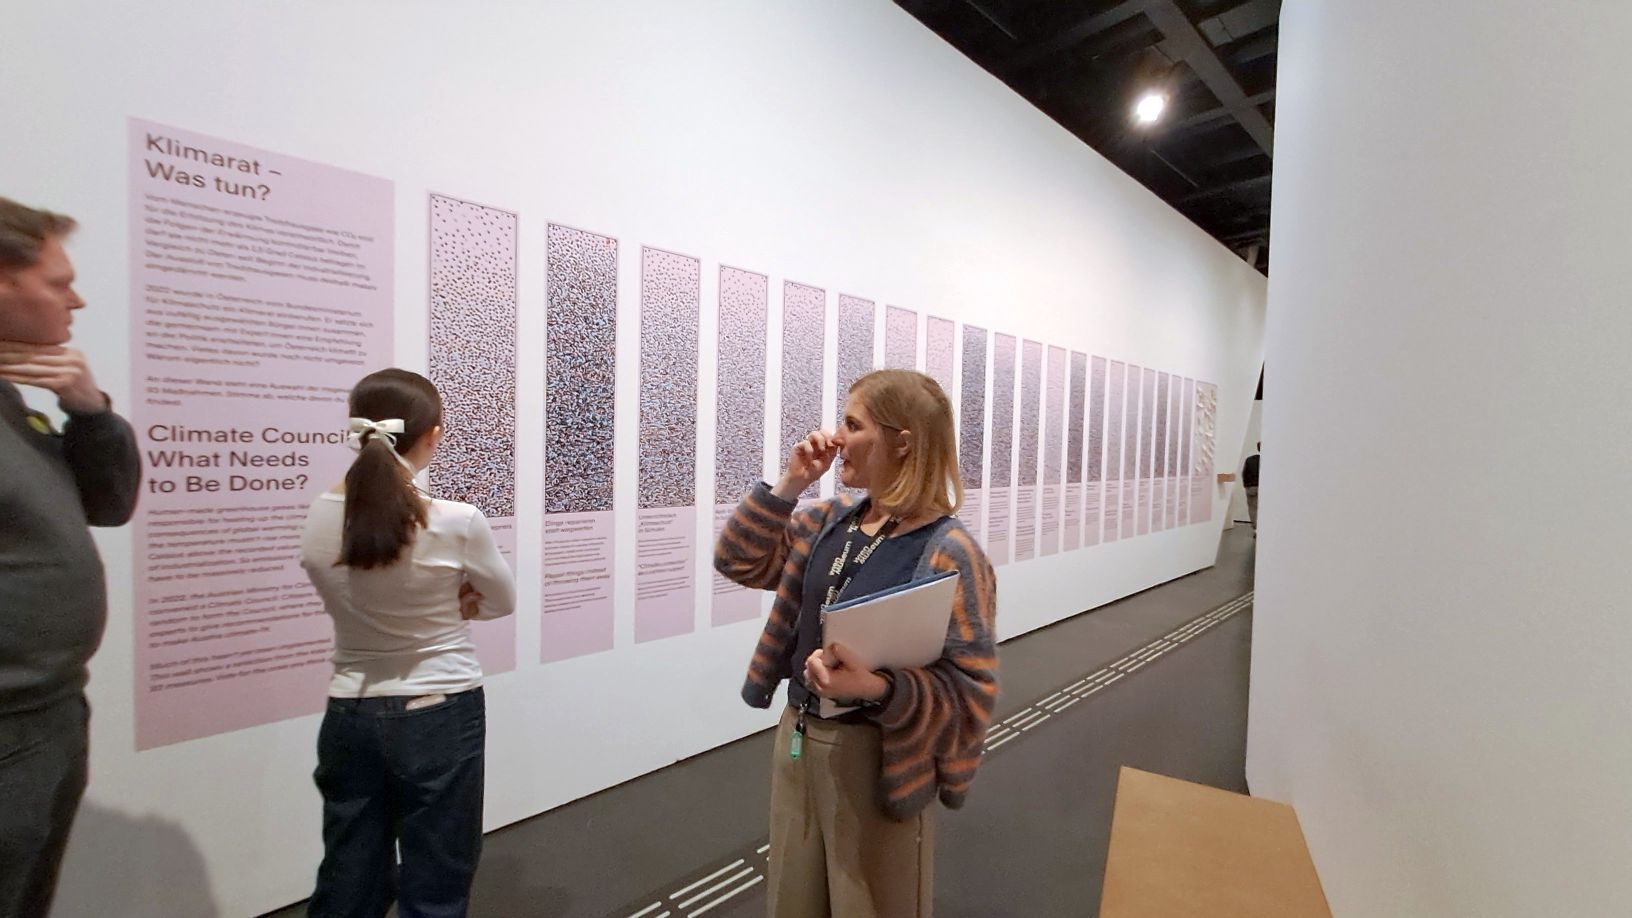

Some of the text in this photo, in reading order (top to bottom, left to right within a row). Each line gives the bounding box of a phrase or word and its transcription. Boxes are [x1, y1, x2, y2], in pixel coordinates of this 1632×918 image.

[145, 132, 261, 177] Klimarat
[144, 158, 272, 202] Was tun?
[147, 424, 254, 444] Climate
[148, 450, 310, 467] What Needs
[148, 474, 309, 493] to Be Done?
